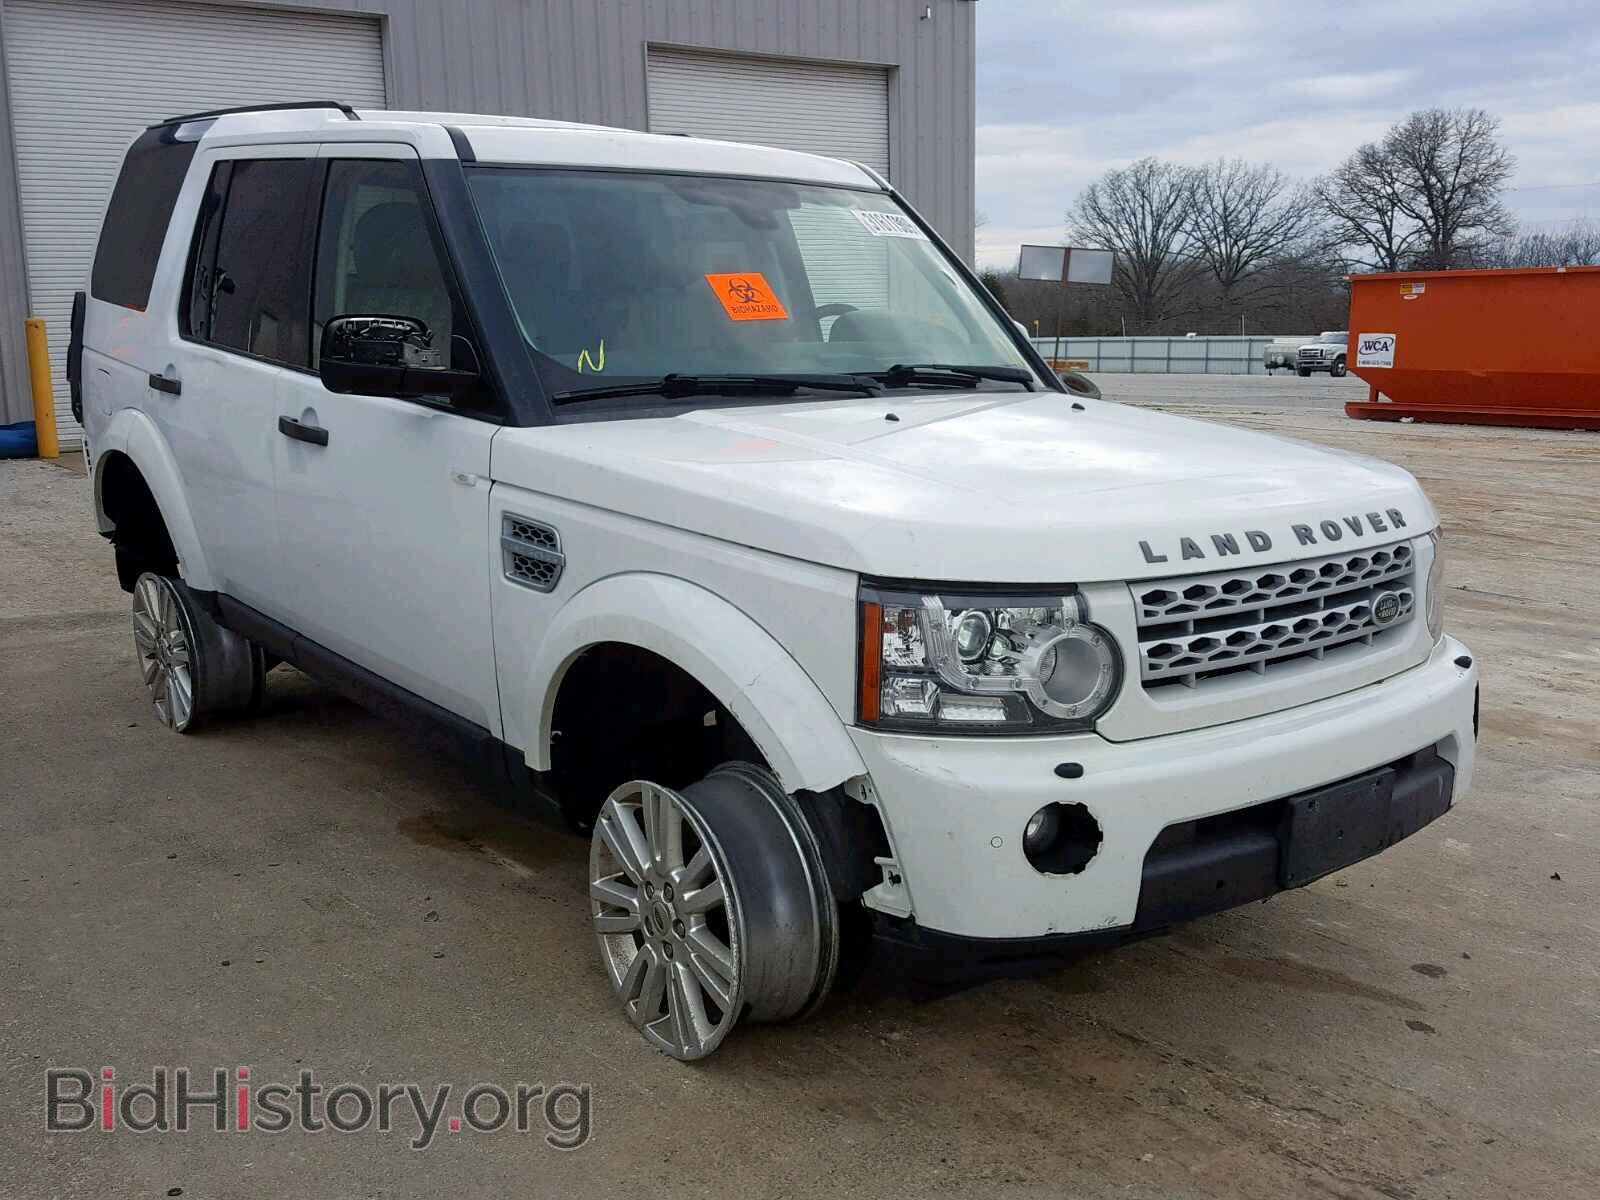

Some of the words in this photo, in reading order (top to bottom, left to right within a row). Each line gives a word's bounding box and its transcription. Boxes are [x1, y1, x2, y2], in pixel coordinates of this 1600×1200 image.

[730, 304, 779, 314] BIOHAZARD
[577, 337, 606, 374] N
[1363, 340, 1390, 352] WCA
[1138, 530, 1273, 564] LAND
[1291, 507, 1407, 546] ROVER
